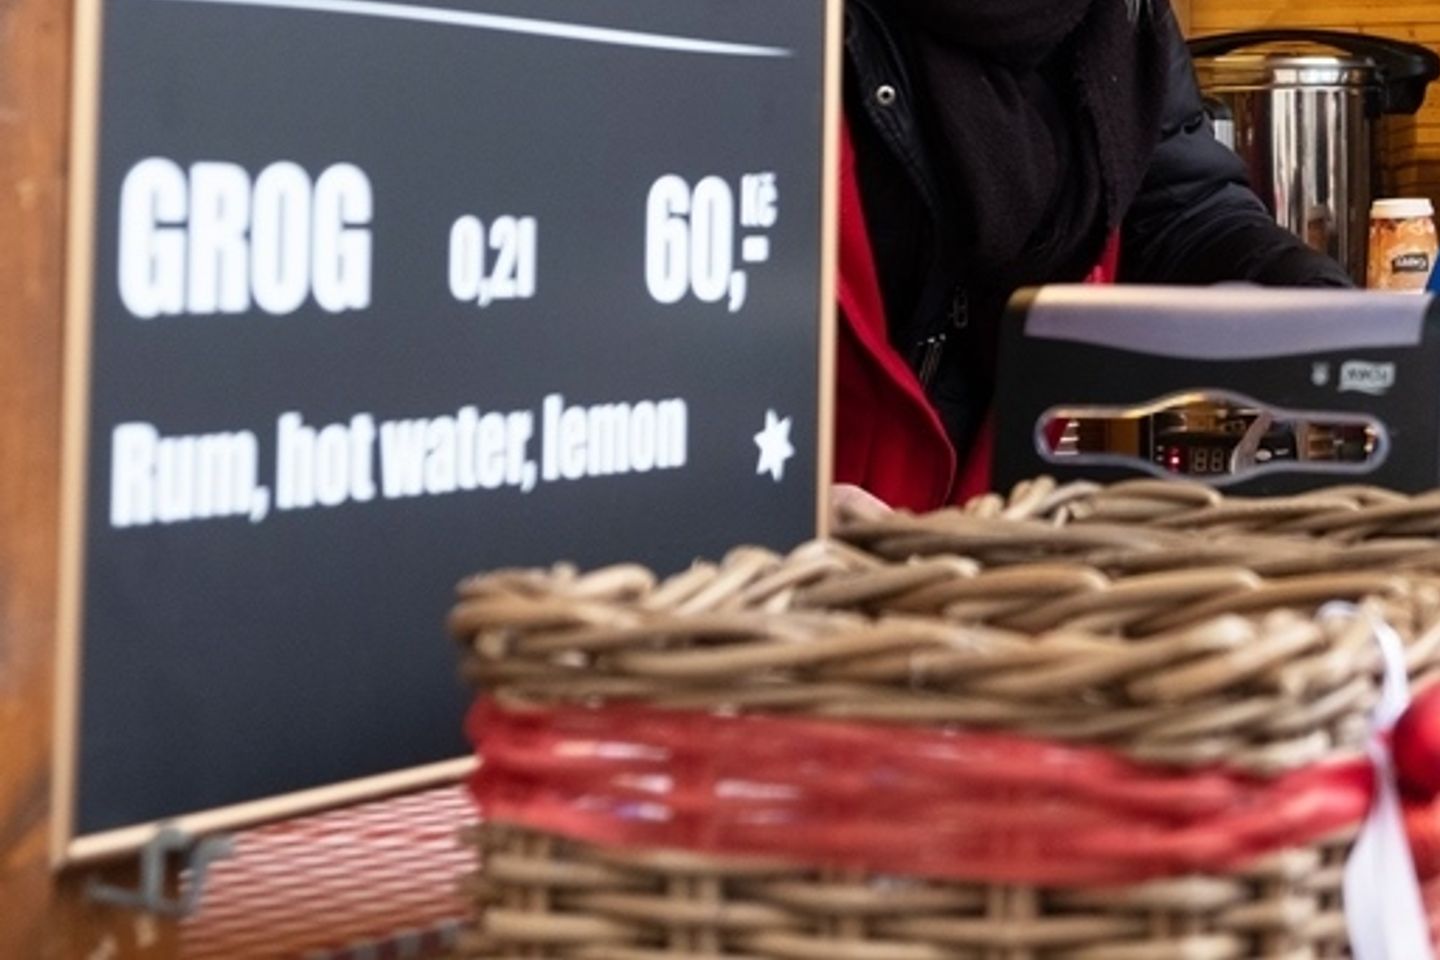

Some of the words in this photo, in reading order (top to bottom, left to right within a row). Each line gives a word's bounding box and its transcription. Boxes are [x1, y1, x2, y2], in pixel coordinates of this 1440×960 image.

[118, 158, 372, 319] GROG
[110, 422, 269, 527] Rum,
[277, 411, 375, 510] hot
[379, 405, 537, 494] water,
[542, 393, 687, 481] lemon
